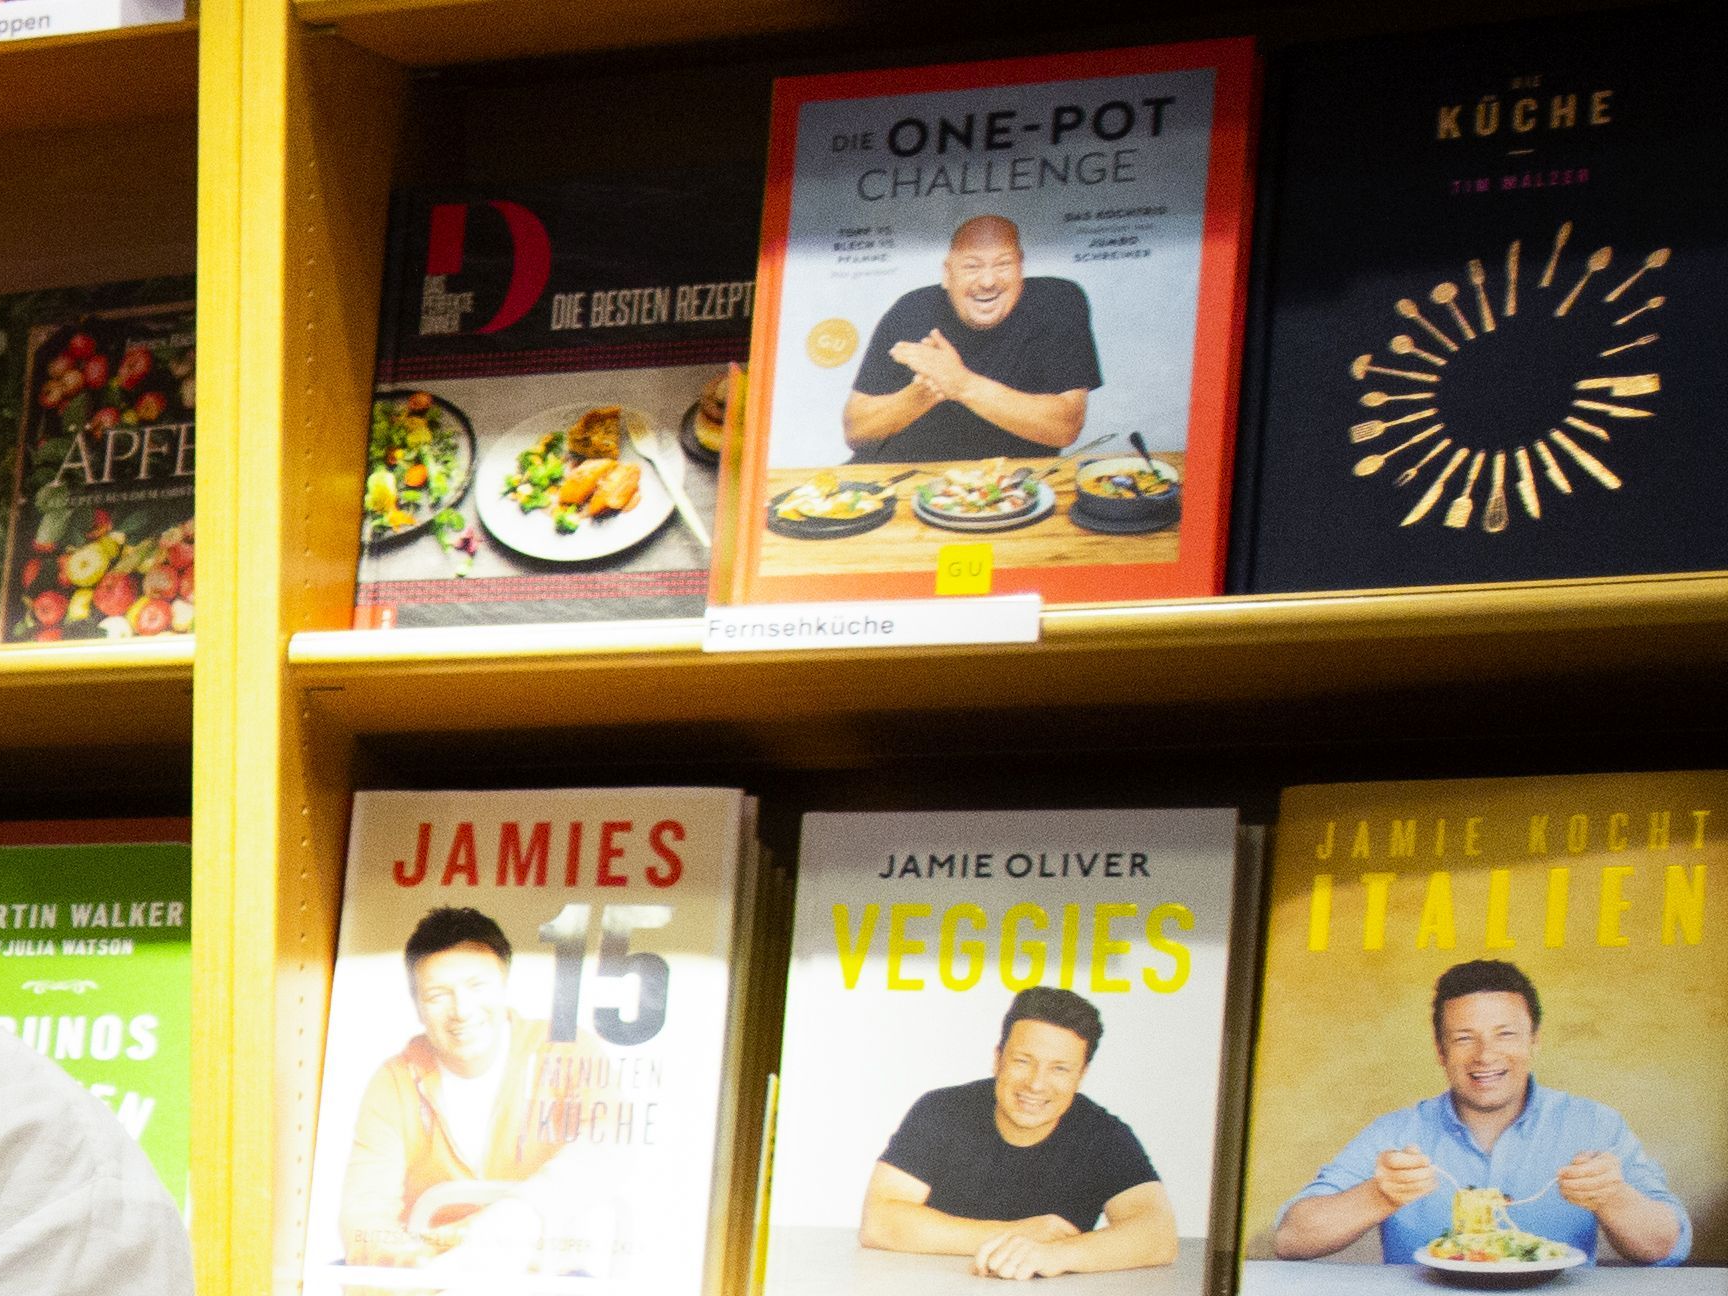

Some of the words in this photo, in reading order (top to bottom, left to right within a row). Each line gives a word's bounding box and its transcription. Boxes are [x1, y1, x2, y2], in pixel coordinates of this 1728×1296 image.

[831, 130, 875, 154] DIE
[888, 96, 1177, 158] ONE-POT
[1436, 88, 1615, 143] KÜCHE
[856, 148, 1139, 203] CHALLENGE
[550, 291, 587, 331] DIE
[588, 285, 671, 327] BESTEN
[708, 613, 896, 641] Fernsehküche
[392, 818, 688, 890] JAMIES
[1315, 814, 1485, 863] JAMIE
[1529, 808, 1714, 857] KOCHT
[877, 852, 994, 882] JAMIE
[1004, 852, 1152, 881] OLIVER
[69, 900, 185, 929] WALKER
[1307, 862, 1709, 954] ITALIEN
[2, 940, 56, 958] JULIA
[61, 939, 135, 957] WATSON
[831, 899, 1197, 995] VEGGIES
[538, 902, 674, 1049] 15
[538, 1055, 665, 1093] MINUTEN
[535, 1090, 660, 1148] KÜCHE
